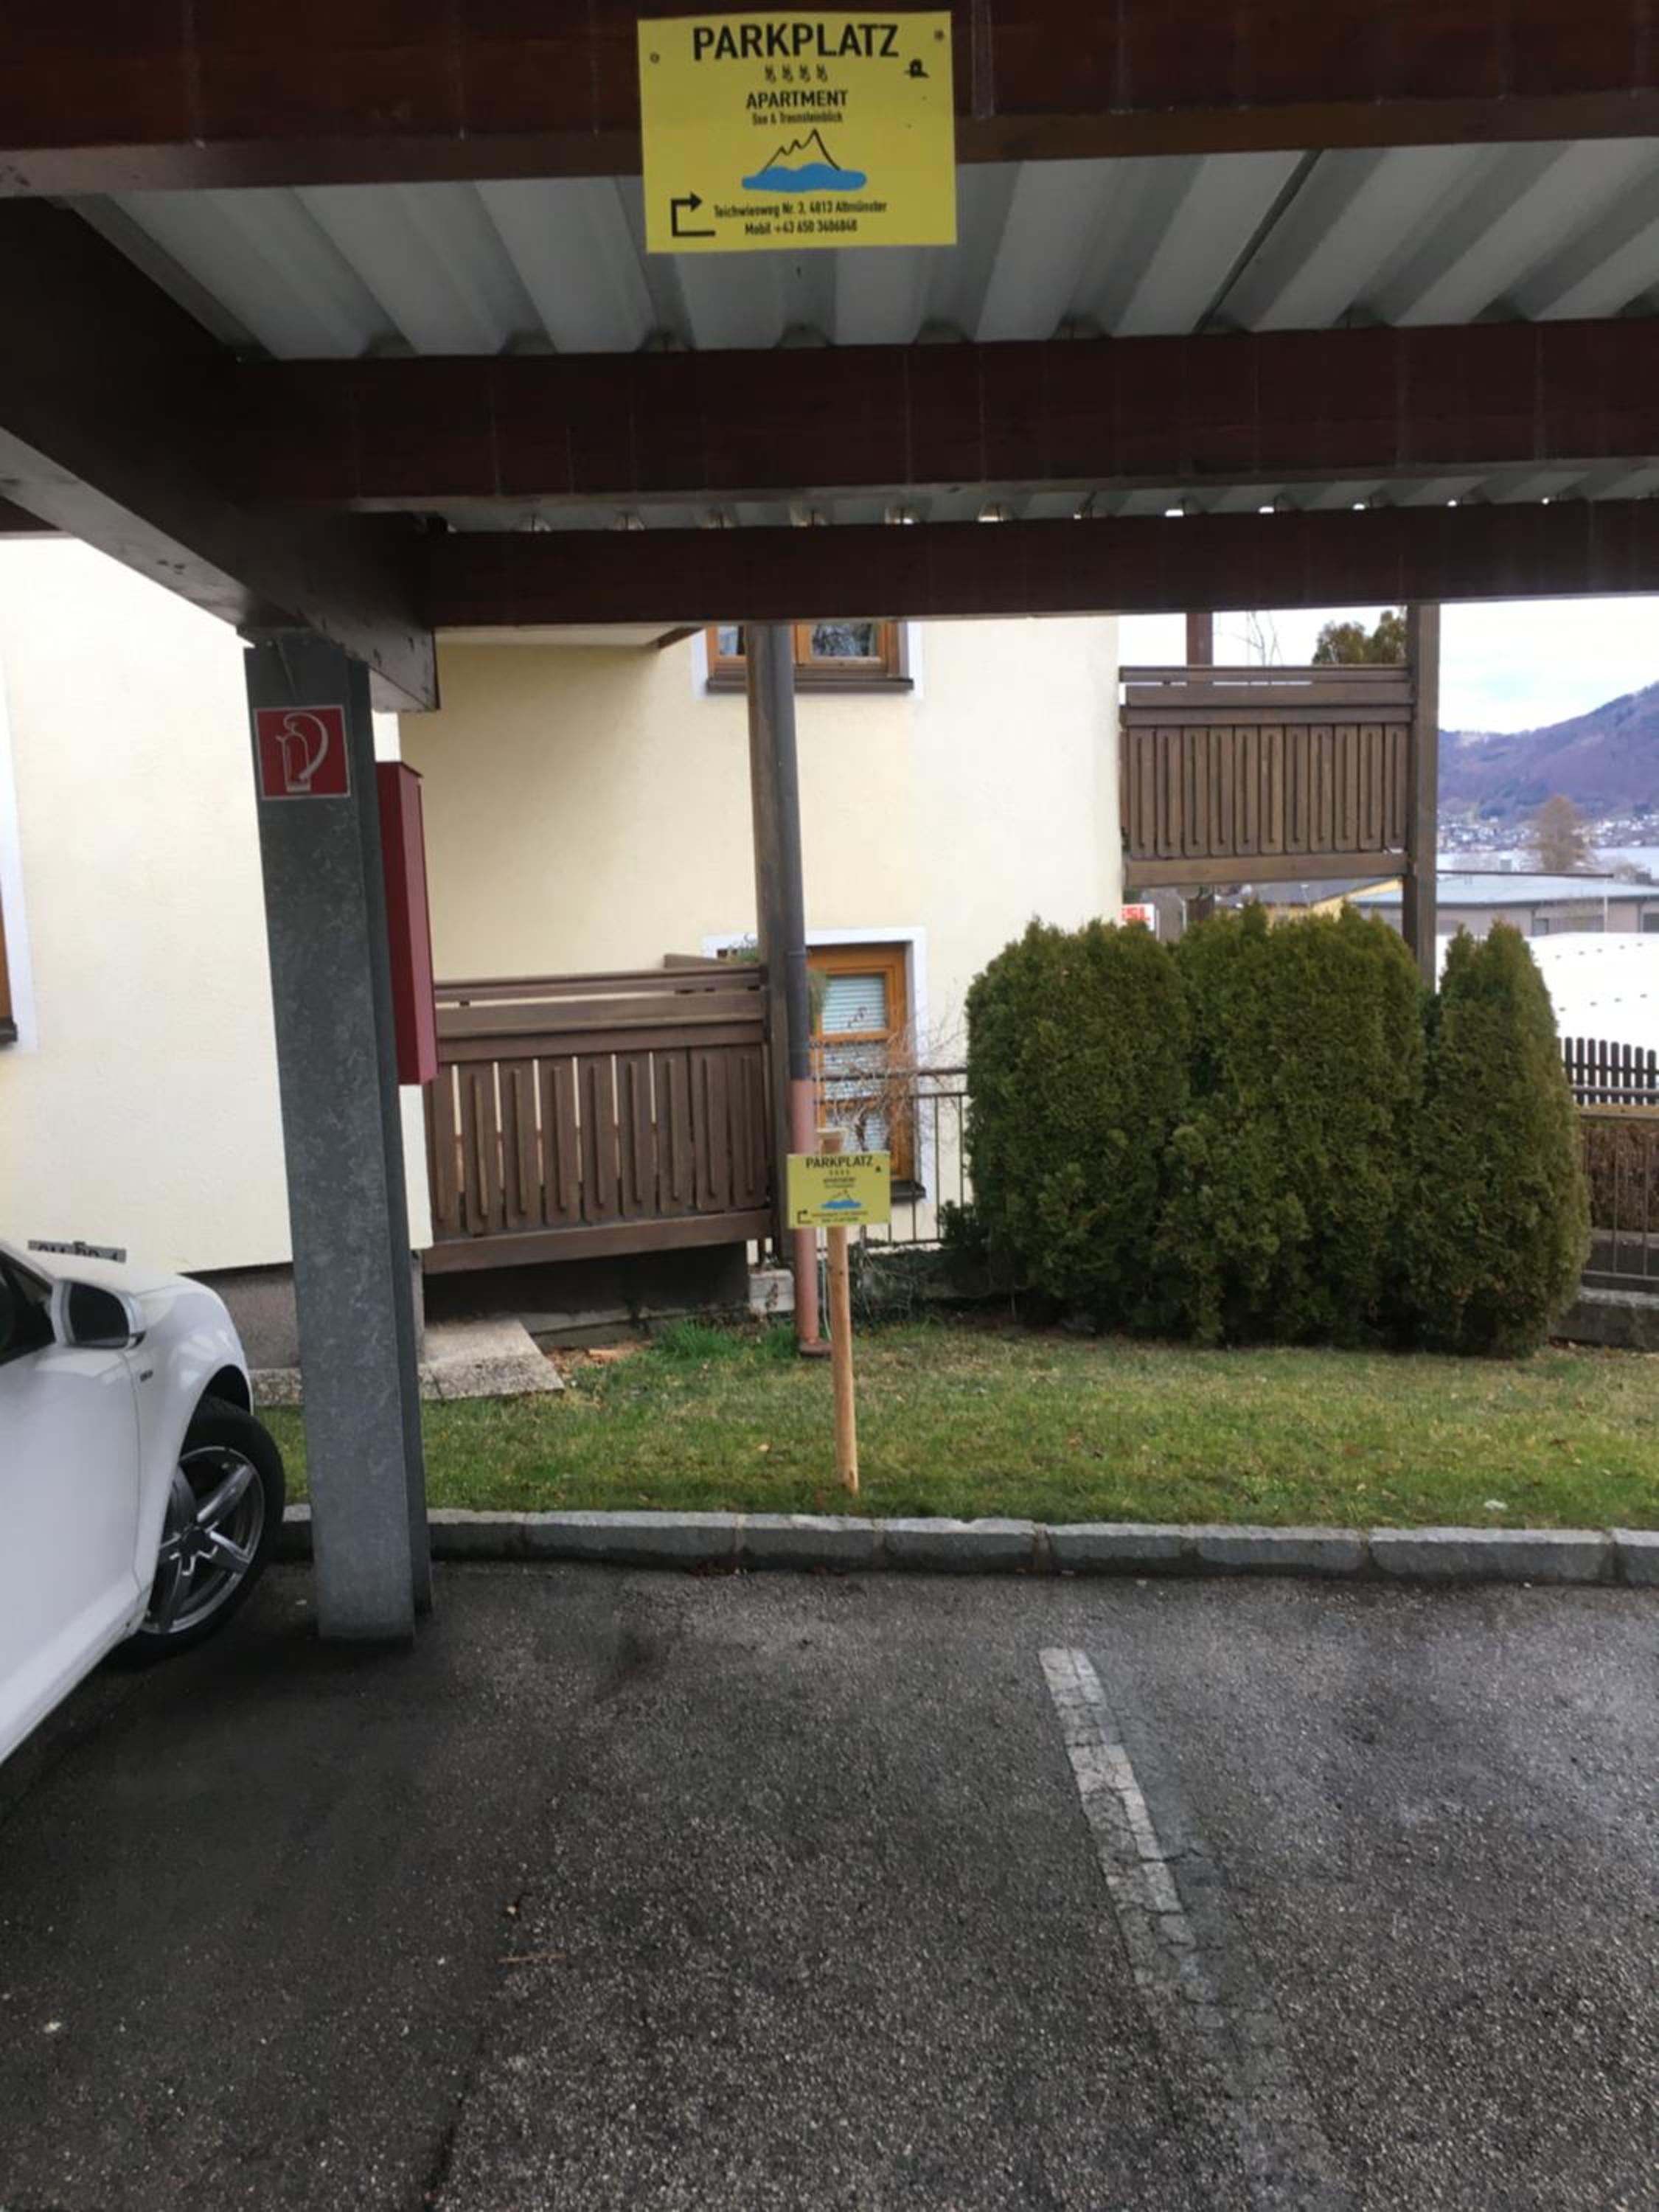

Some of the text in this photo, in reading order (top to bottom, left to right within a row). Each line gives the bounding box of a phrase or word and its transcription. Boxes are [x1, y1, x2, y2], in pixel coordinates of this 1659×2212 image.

[693, 23, 899, 60] PARKPLATZ
[746, 89, 848, 109] APARTMENT
[810, 200, 832, 215] 4813
[806, 1155, 873, 1169] PARKPLATZ
